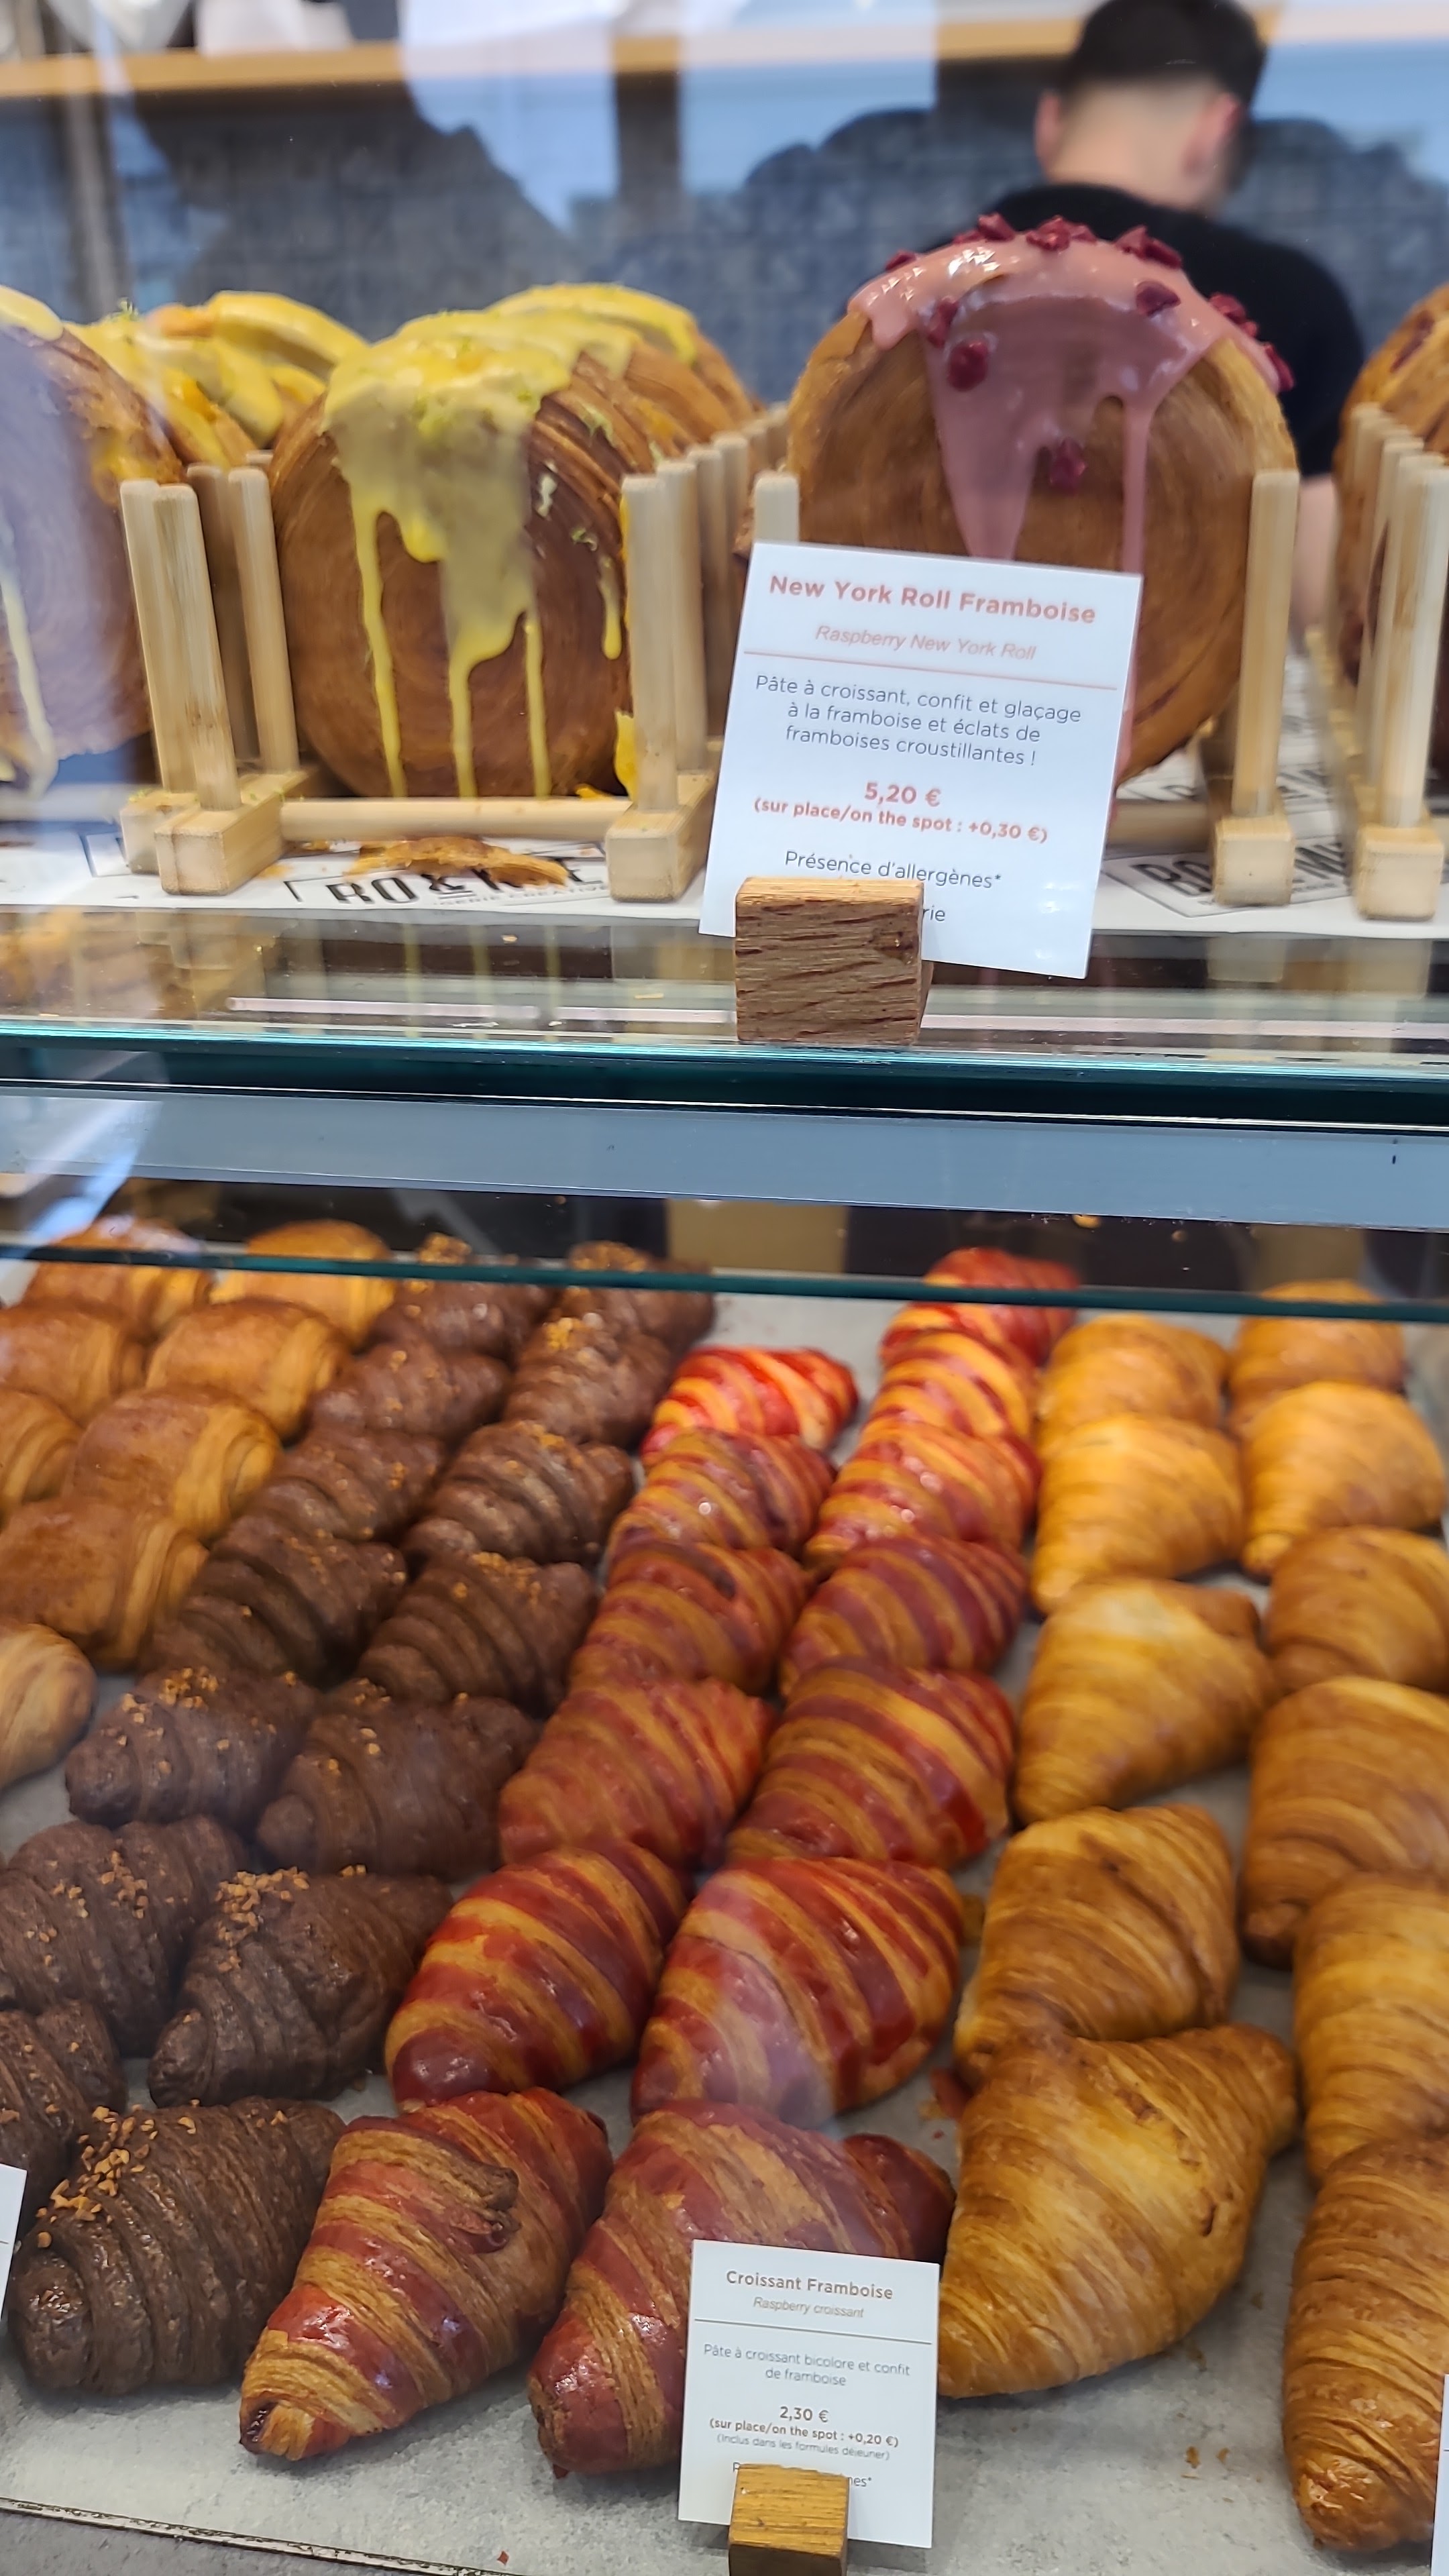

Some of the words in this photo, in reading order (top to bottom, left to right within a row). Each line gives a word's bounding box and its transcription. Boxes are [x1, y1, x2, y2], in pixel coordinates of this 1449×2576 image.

[770, 576, 824, 597] New
[835, 582, 892, 604] York
[902, 587, 950, 608] Roll
[960, 593, 1095, 623] Framboise
[816, 625, 906, 651] Raspberry
[910, 634, 951, 651] New
[959, 639, 996, 656] York
[1001, 643, 1036, 659] Roll
[756, 676, 798, 693] Pâte
[804, 680, 814, 694] à
[821, 684, 910, 706] croissant,
[918, 694, 972, 711] confit
[979, 699, 998, 714] et
[1005, 700, 1081, 723] glaçage
[788, 702, 798, 717] à
[806, 703, 819, 719] la
[828, 706, 921, 729] framboise
[928, 718, 947, 732] et
[954, 719, 1009, 739] éclats
[1016, 725, 1040, 742] de
[787, 725, 890, 750] framboises
[897, 741, 1024, 764] croustillantes
[865, 782, 916, 804] 5,20
[926, 789, 940, 806] €
[755, 798, 788, 812] (sur
[794, 802, 872, 822] place/on
[879, 811, 906, 826] the
[912, 817, 951, 831] spot
[969, 822, 1021, 839] +0,30
[1028, 827, 1046, 843] €)
[786, 851, 871, 874] Présence
[727, 2271, 801, 2290] Croissant
[808, 2278, 892, 2299] Framboise
[753, 2297, 810, 2315] Raspberry
[814, 2306, 864, 2318] croissant
[704, 2344, 731, 2357] Pâte
[735, 2346, 742, 2359] à
[746, 2351, 800, 2364] croissant
[805, 2354, 854, 2369] bicolore
[858, 2361, 869, 2371] et
[874, 2363, 910, 2375] confit
[765, 2367, 781, 2379] de
[785, 2369, 846, 2385] framboise
[780, 2406, 812, 2420] 2,30
[819, 2410, 828, 2422] €
[710, 2418, 731, 2428] (sur
[735, 2420, 786, 2434] place/on
[790, 2426, 808, 2436] the
[812, 2430, 837, 2440] spot
[849, 2433, 881, 2445] +0,20
[886, 2436, 898, 2447] €)
[753, 2438, 775, 2447] dans
[780, 2440, 792, 2449] les
[796, 2441, 839, 2454] formules
